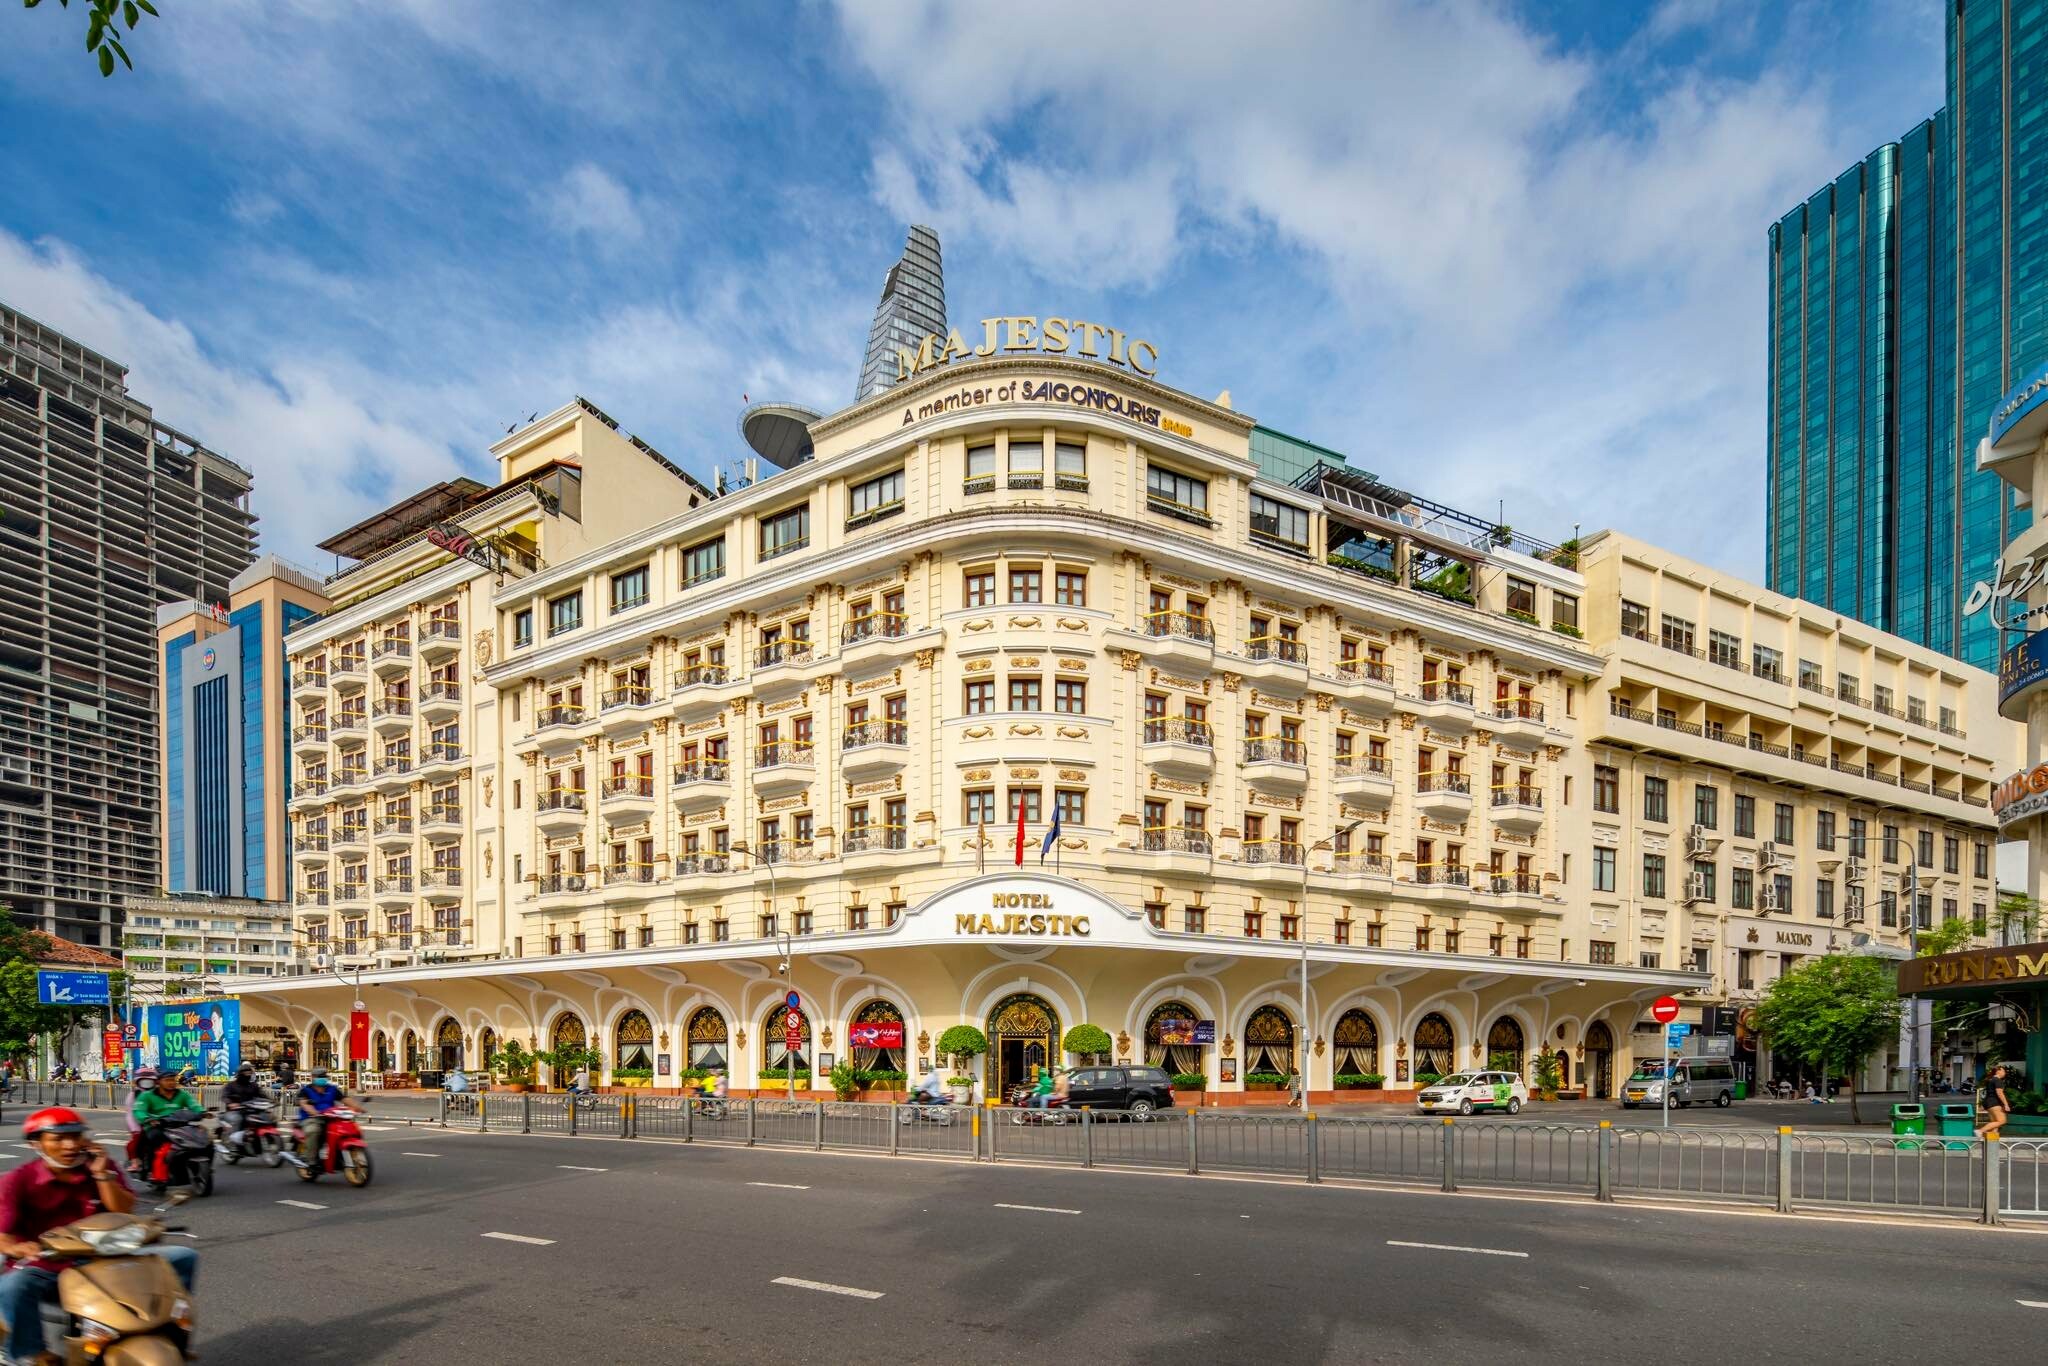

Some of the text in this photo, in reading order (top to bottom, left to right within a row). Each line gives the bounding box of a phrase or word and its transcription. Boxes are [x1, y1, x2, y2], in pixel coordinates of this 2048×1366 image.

[895, 316, 1158, 383] MAJESTIC
[902, 408, 914, 426] A
[918, 387, 992, 419] member
[997, 380, 1016, 401] of
[1021, 380, 1161, 427] SAIGONTOURIST
[992, 893, 1054, 909] HOTEL
[955, 913, 1091, 936] MAJESTIC
[1922, 952, 2048, 986] RUNAM
[164, 1031, 201, 1058] SOJU
